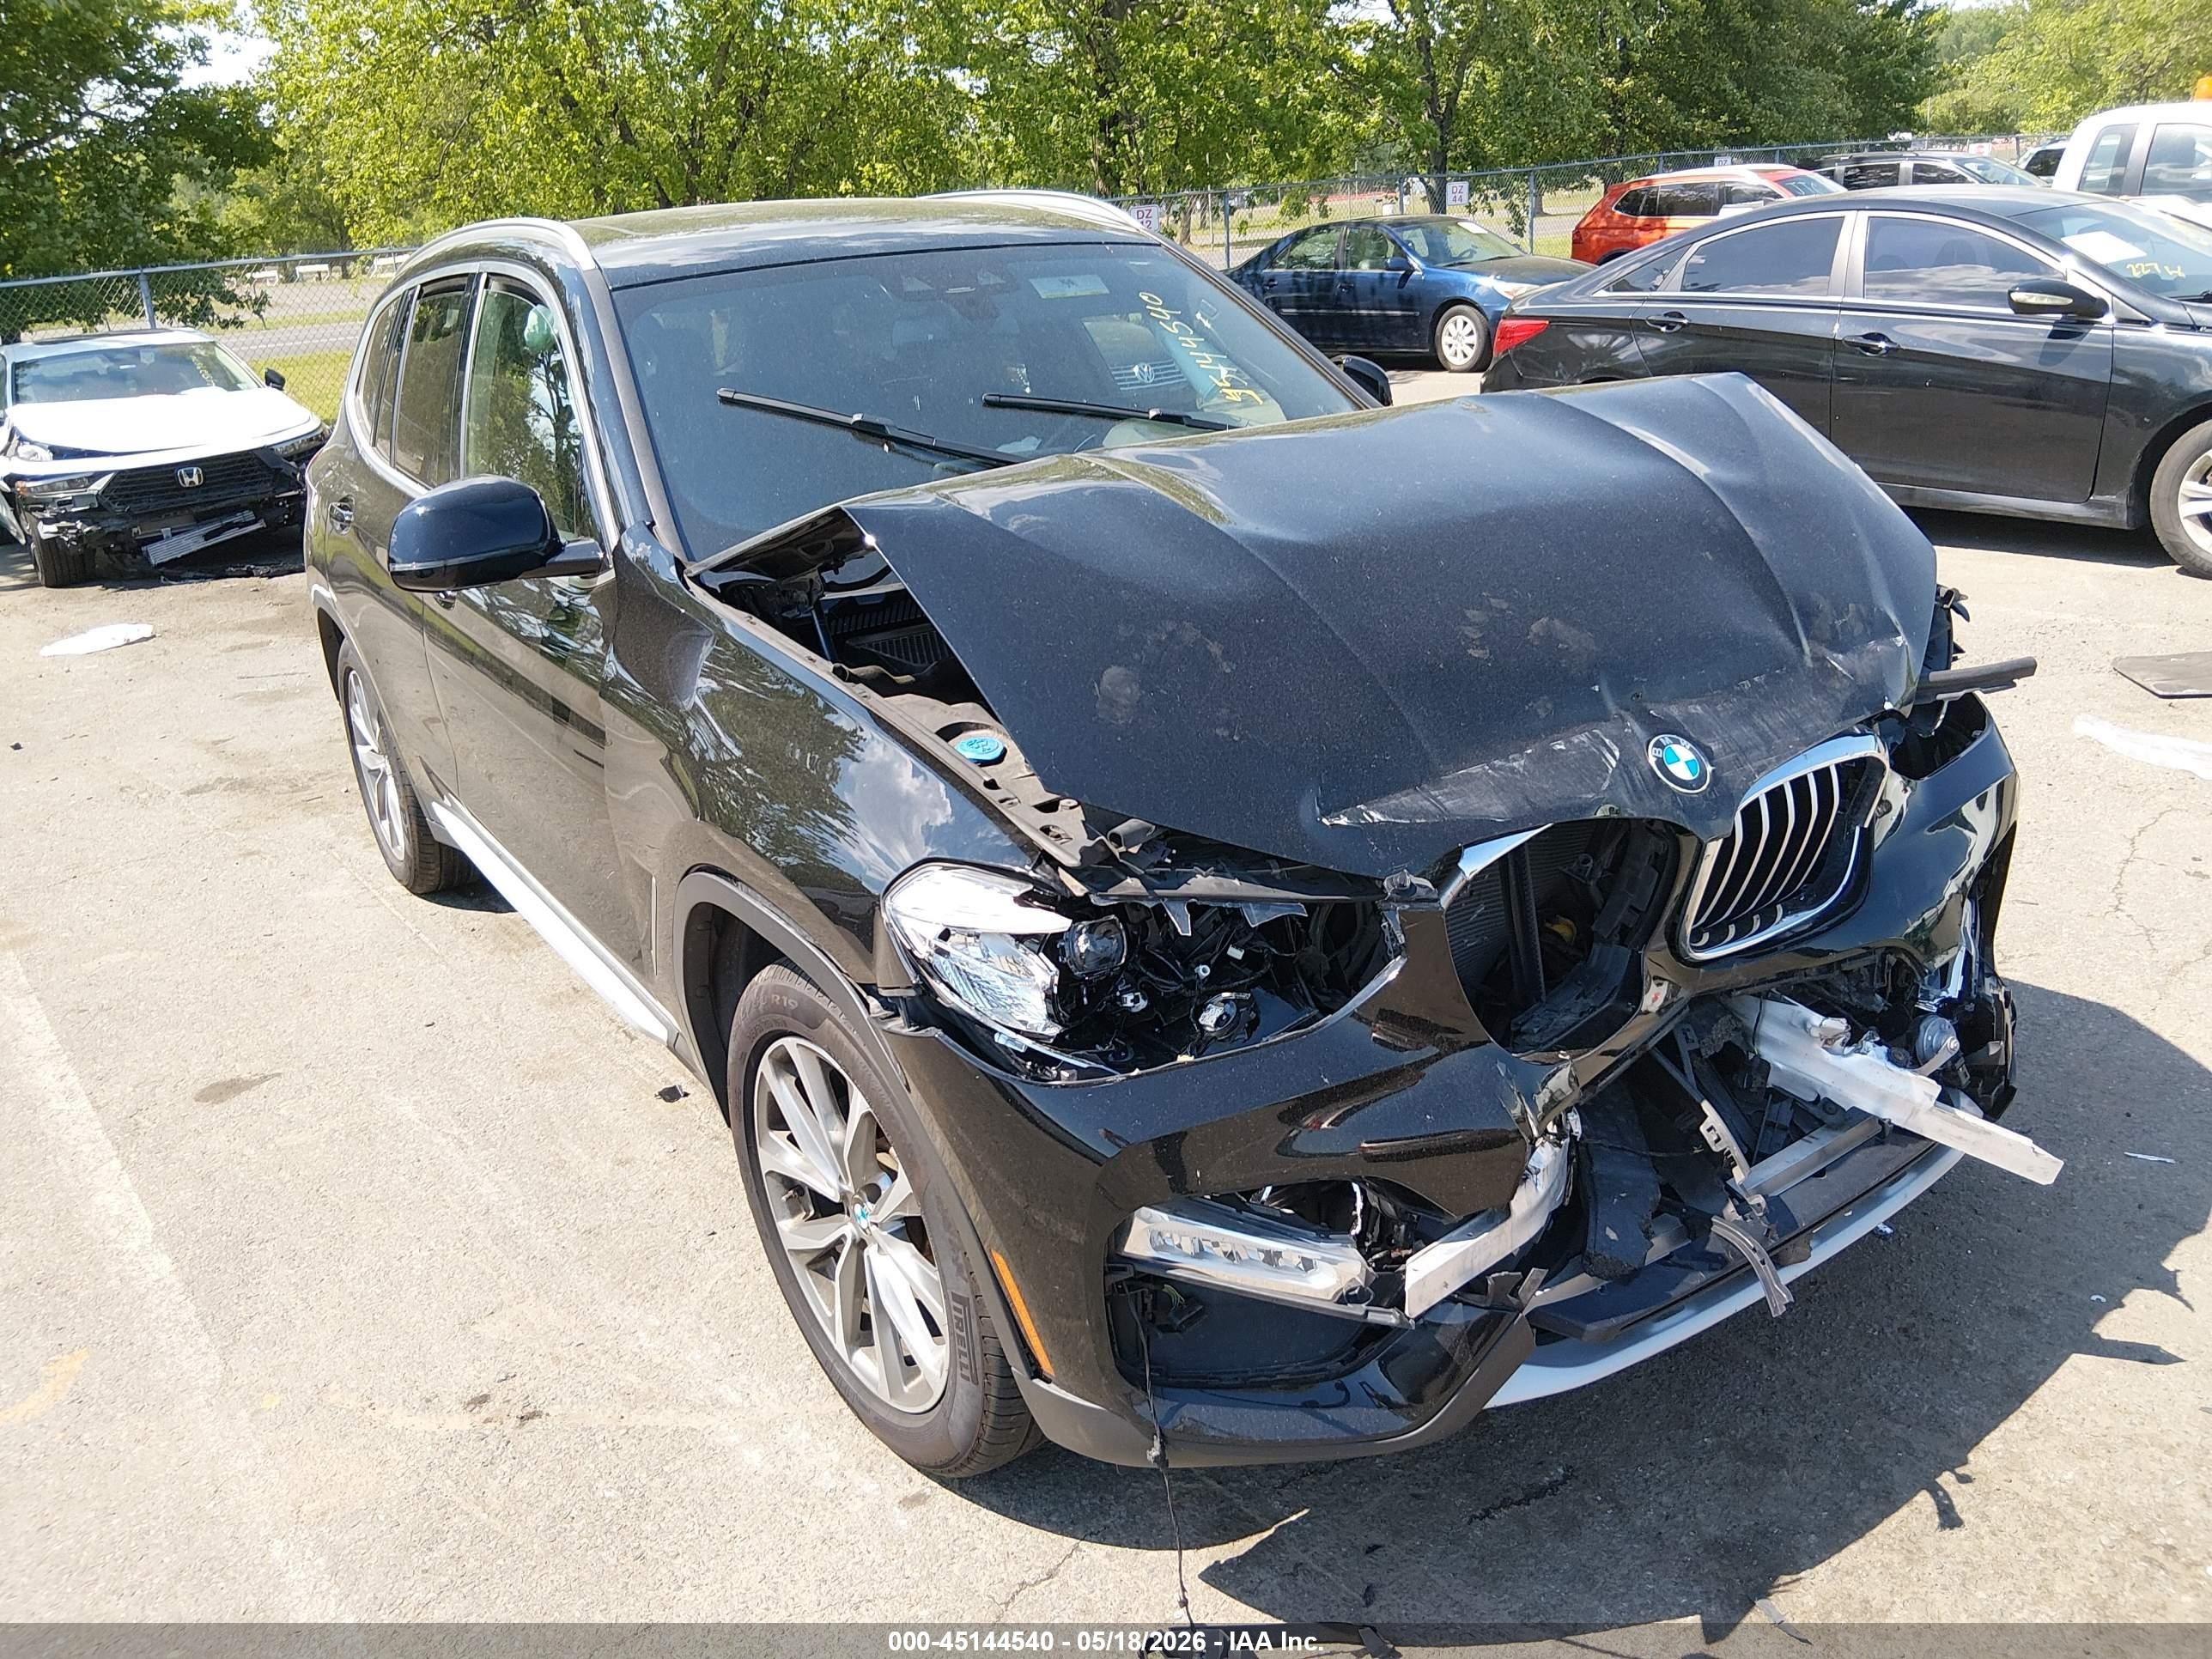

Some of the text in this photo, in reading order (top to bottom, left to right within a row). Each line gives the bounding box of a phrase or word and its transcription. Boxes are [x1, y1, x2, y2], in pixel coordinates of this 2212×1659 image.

[1451, 185, 1464, 194] DZ
[1451, 194, 1463, 204] 44
[1136, 208, 1152, 220] DZ
[771, 994, 799, 1011] R19
[951, 1291, 979, 1386] PIRELLI
